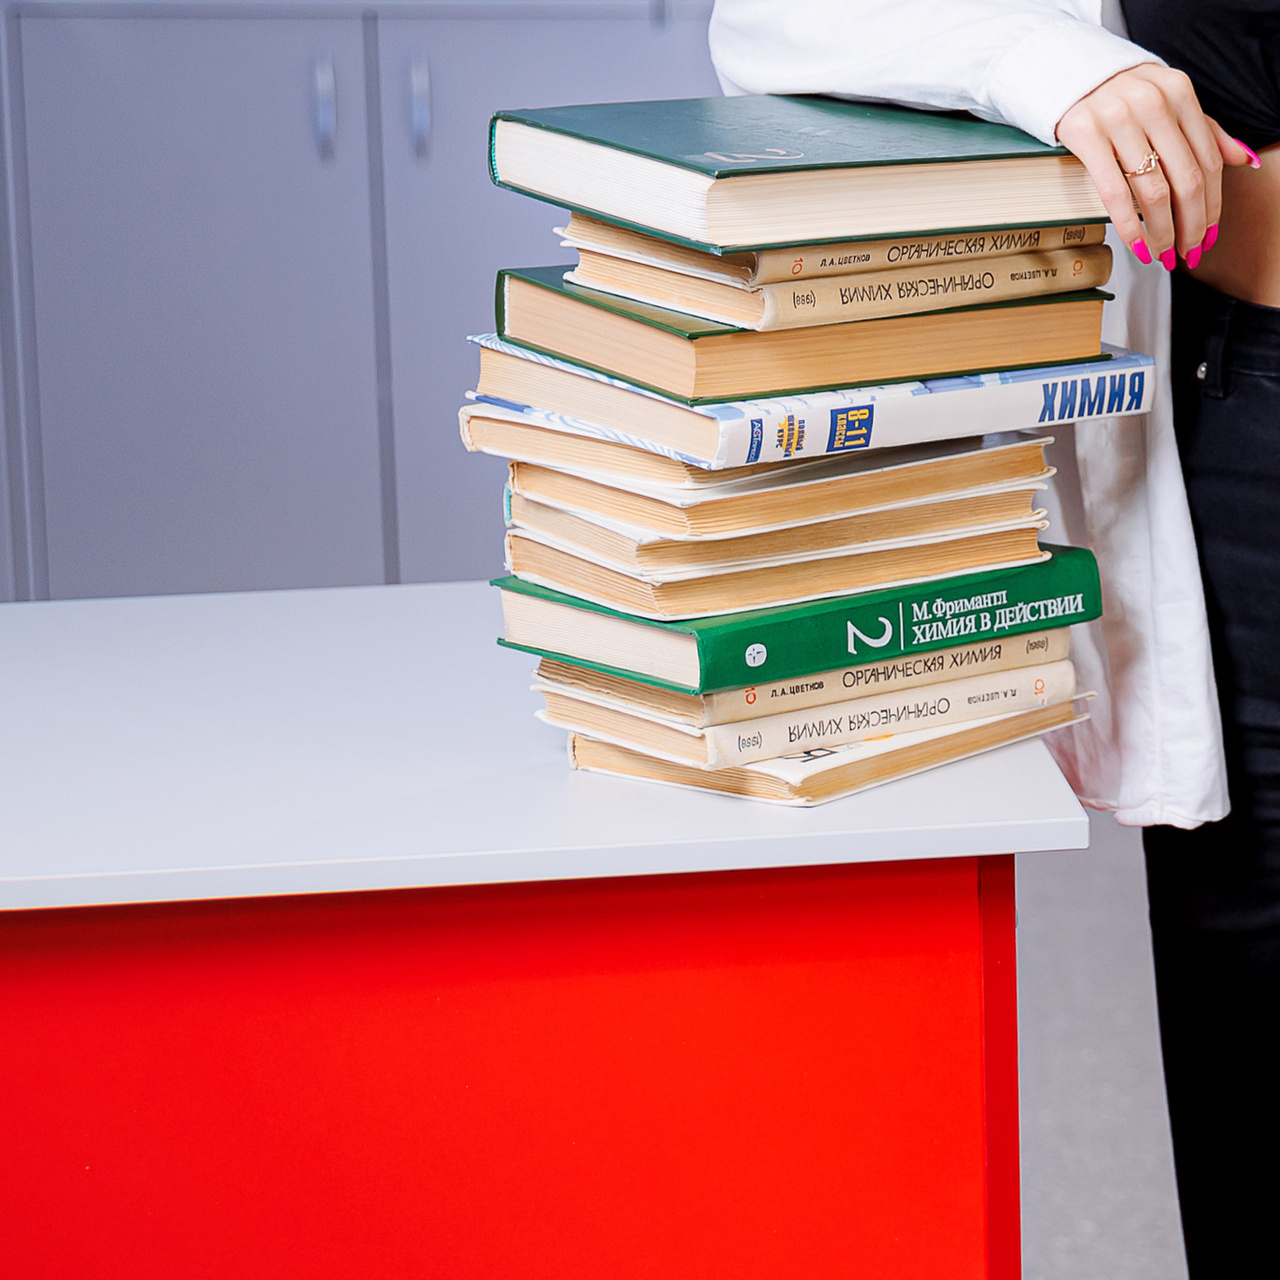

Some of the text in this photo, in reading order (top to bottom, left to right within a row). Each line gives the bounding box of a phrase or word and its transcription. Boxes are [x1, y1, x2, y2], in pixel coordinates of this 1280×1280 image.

[887, 236, 986, 263] ОРГАНИЧЕСКАЯ
[988, 230, 1041, 252] ХИМИЯ
[792, 271, 995, 309] ОРГАНИЧЕСКАЯ ХИМИЯ (1988)
[1037, 371, 1145, 423] ХИМИЯ
[844, 408, 870, 446] 8-11
[911, 589, 1008, 623] М.Фримантл
[911, 592, 1086, 645] ХИМИЯ В ДЕЙСТВИИ
[846, 616, 893, 655] 2
[842, 655, 945, 689] ОРГАНИЧЕСКАЯ
[949, 643, 1003, 669] ХИМИЯ
[788, 716, 843, 743] ХИМИЯ
[848, 697, 951, 732] ОРГАНИЧЕСКАЯ
